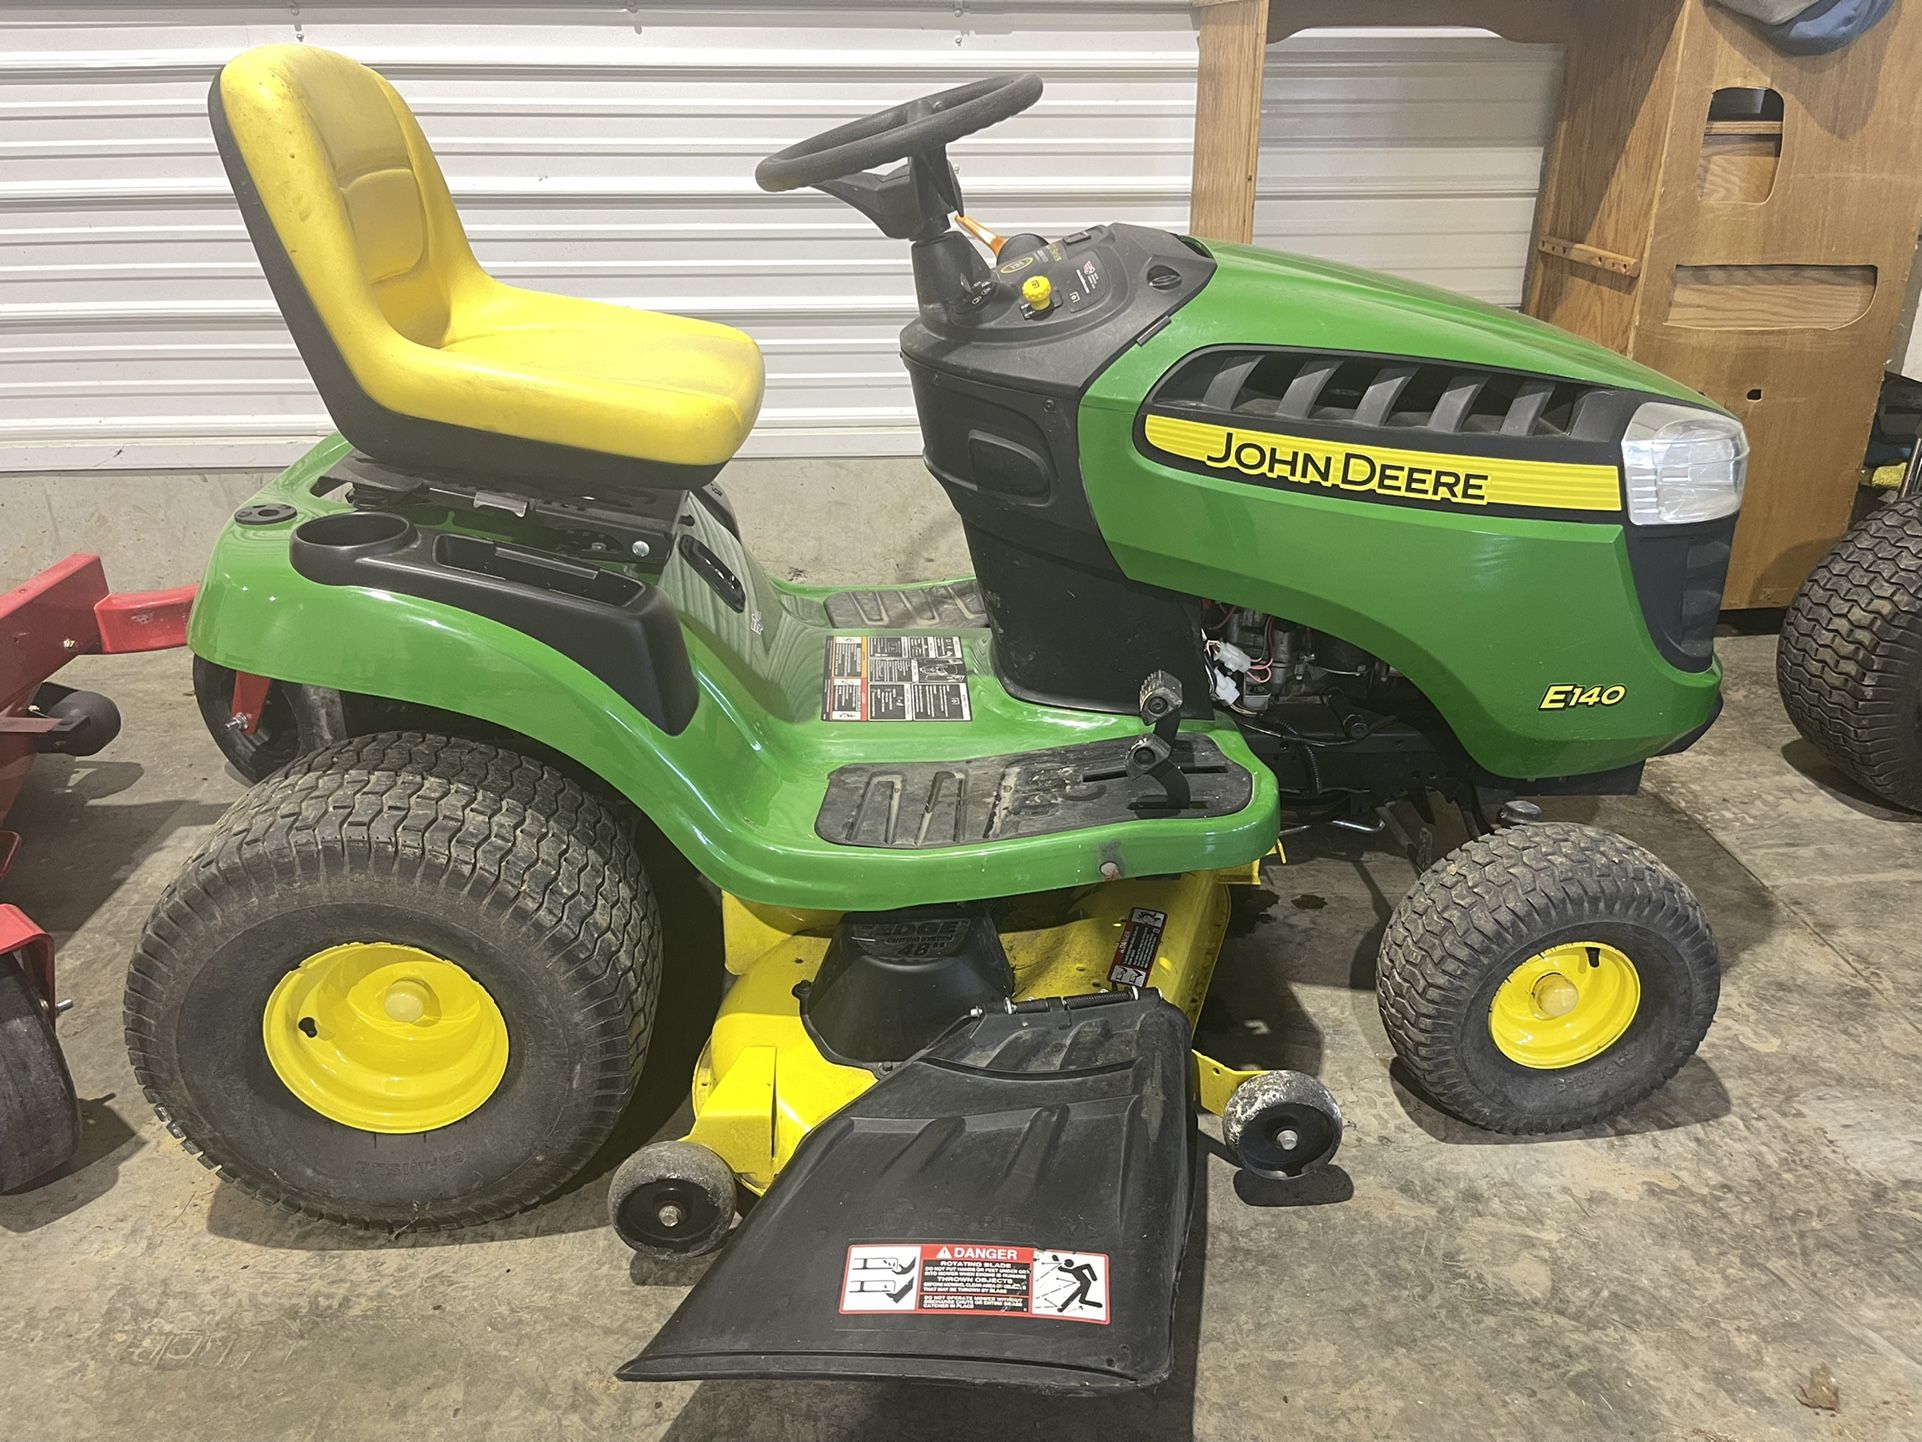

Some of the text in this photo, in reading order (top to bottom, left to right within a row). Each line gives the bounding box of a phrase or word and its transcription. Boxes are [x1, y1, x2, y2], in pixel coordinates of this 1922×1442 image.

[1206, 432, 1489, 501] JOHN DEERE
[1539, 684, 1626, 710] E140
[954, 1247, 1017, 1260] DANGER
